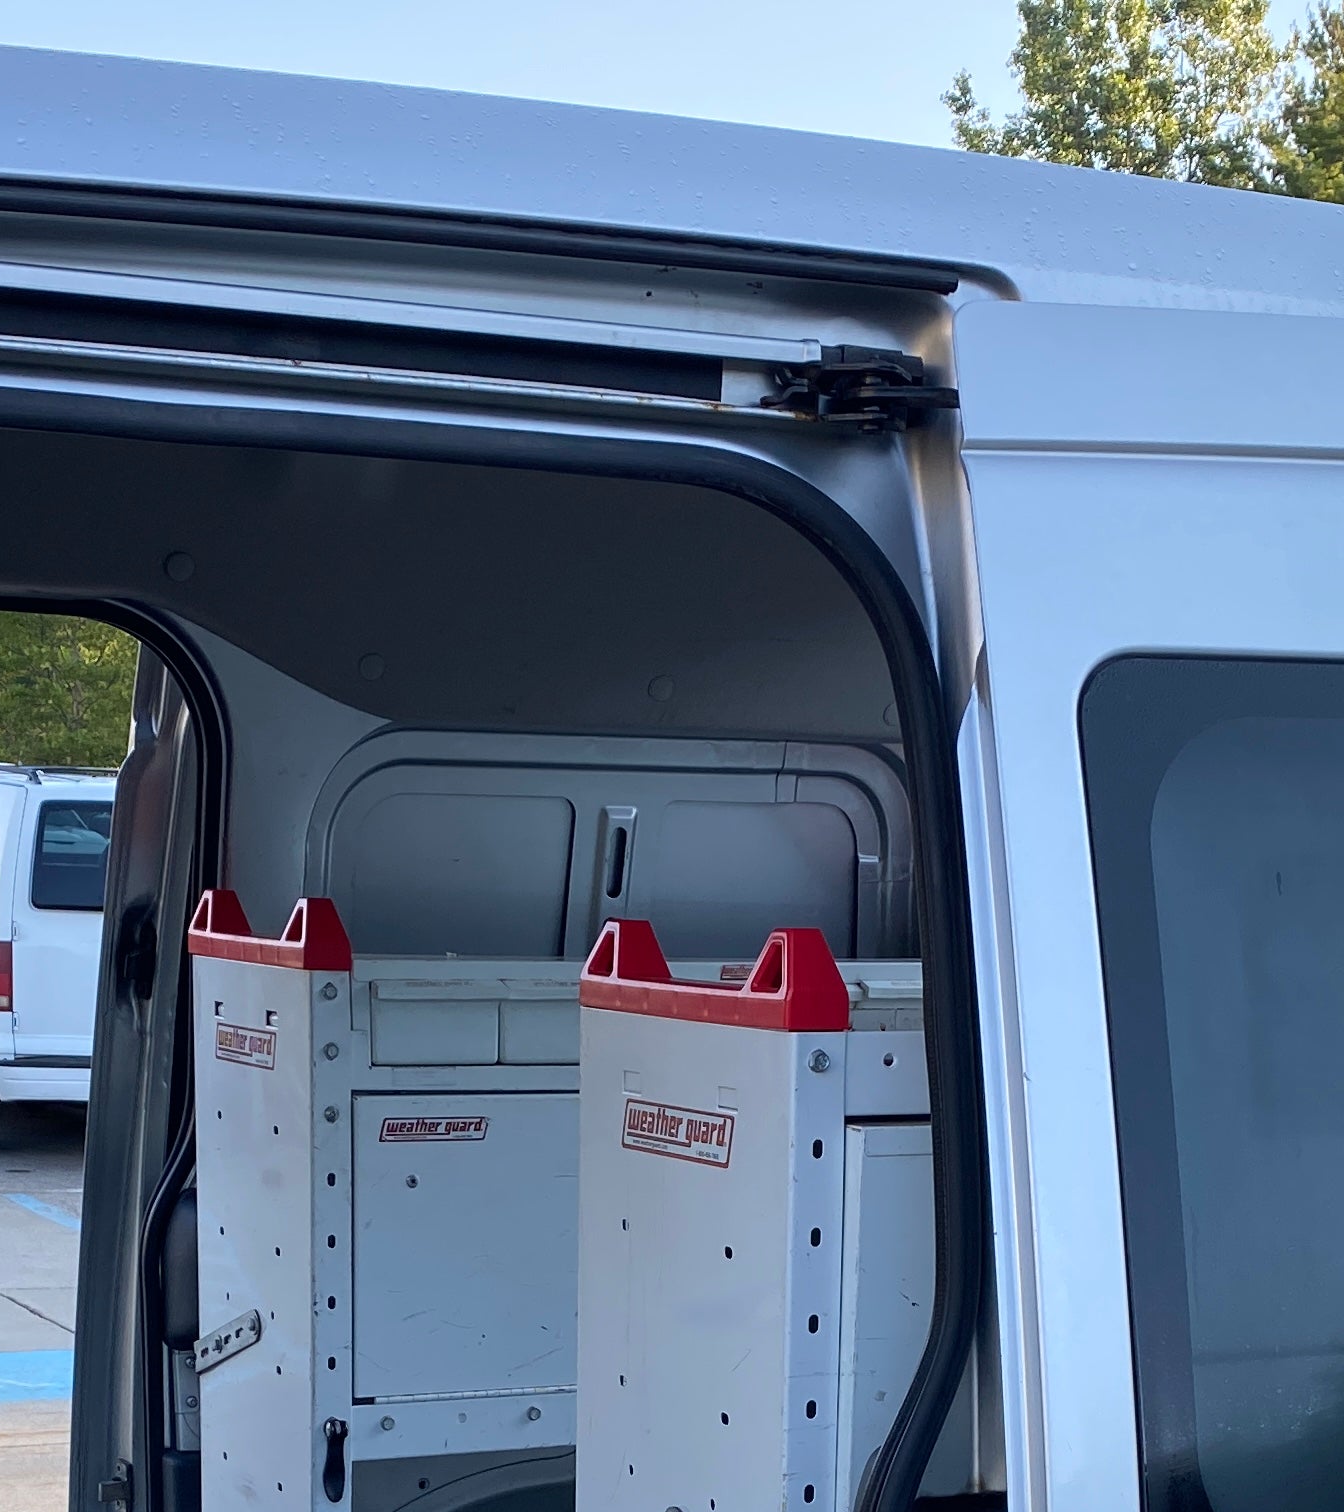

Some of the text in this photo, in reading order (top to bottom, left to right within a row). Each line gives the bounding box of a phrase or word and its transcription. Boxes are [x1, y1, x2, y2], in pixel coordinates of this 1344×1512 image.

[218, 1028, 273, 1056] weather guard
[386, 1118, 484, 1134] weather guard
[627, 1107, 727, 1147] weather guard
